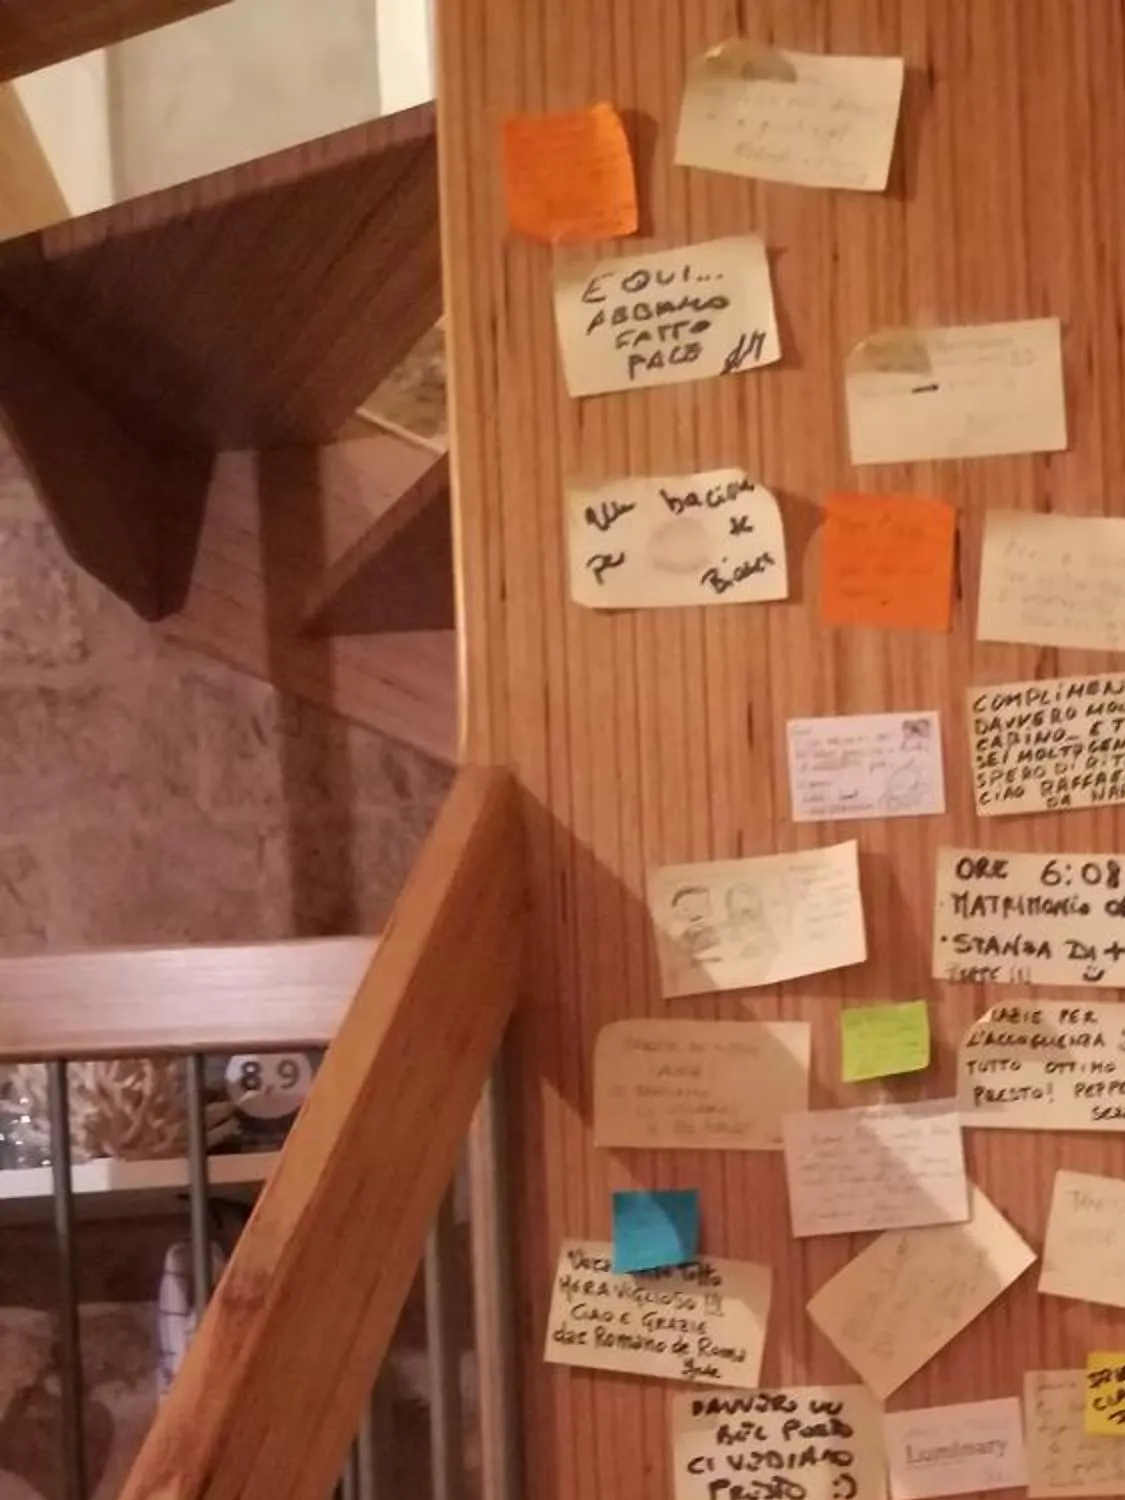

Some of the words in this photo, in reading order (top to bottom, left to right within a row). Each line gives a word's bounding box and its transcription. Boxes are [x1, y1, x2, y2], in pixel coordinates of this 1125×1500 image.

[975, 707, 1078, 736] DAVVERO
[976, 765, 1047, 789] SPERO
[979, 784, 1026, 806] CIAO
[955, 856, 1009, 881] ORE
[1039, 859, 1122, 889] 6:08
[951, 890, 1092, 919] MATRIMONIO
[1058, 1008, 1098, 1024] PER
[965, 1058, 1021, 1076] TUTTO
[1044, 1059, 1118, 1075] OTTIMO
